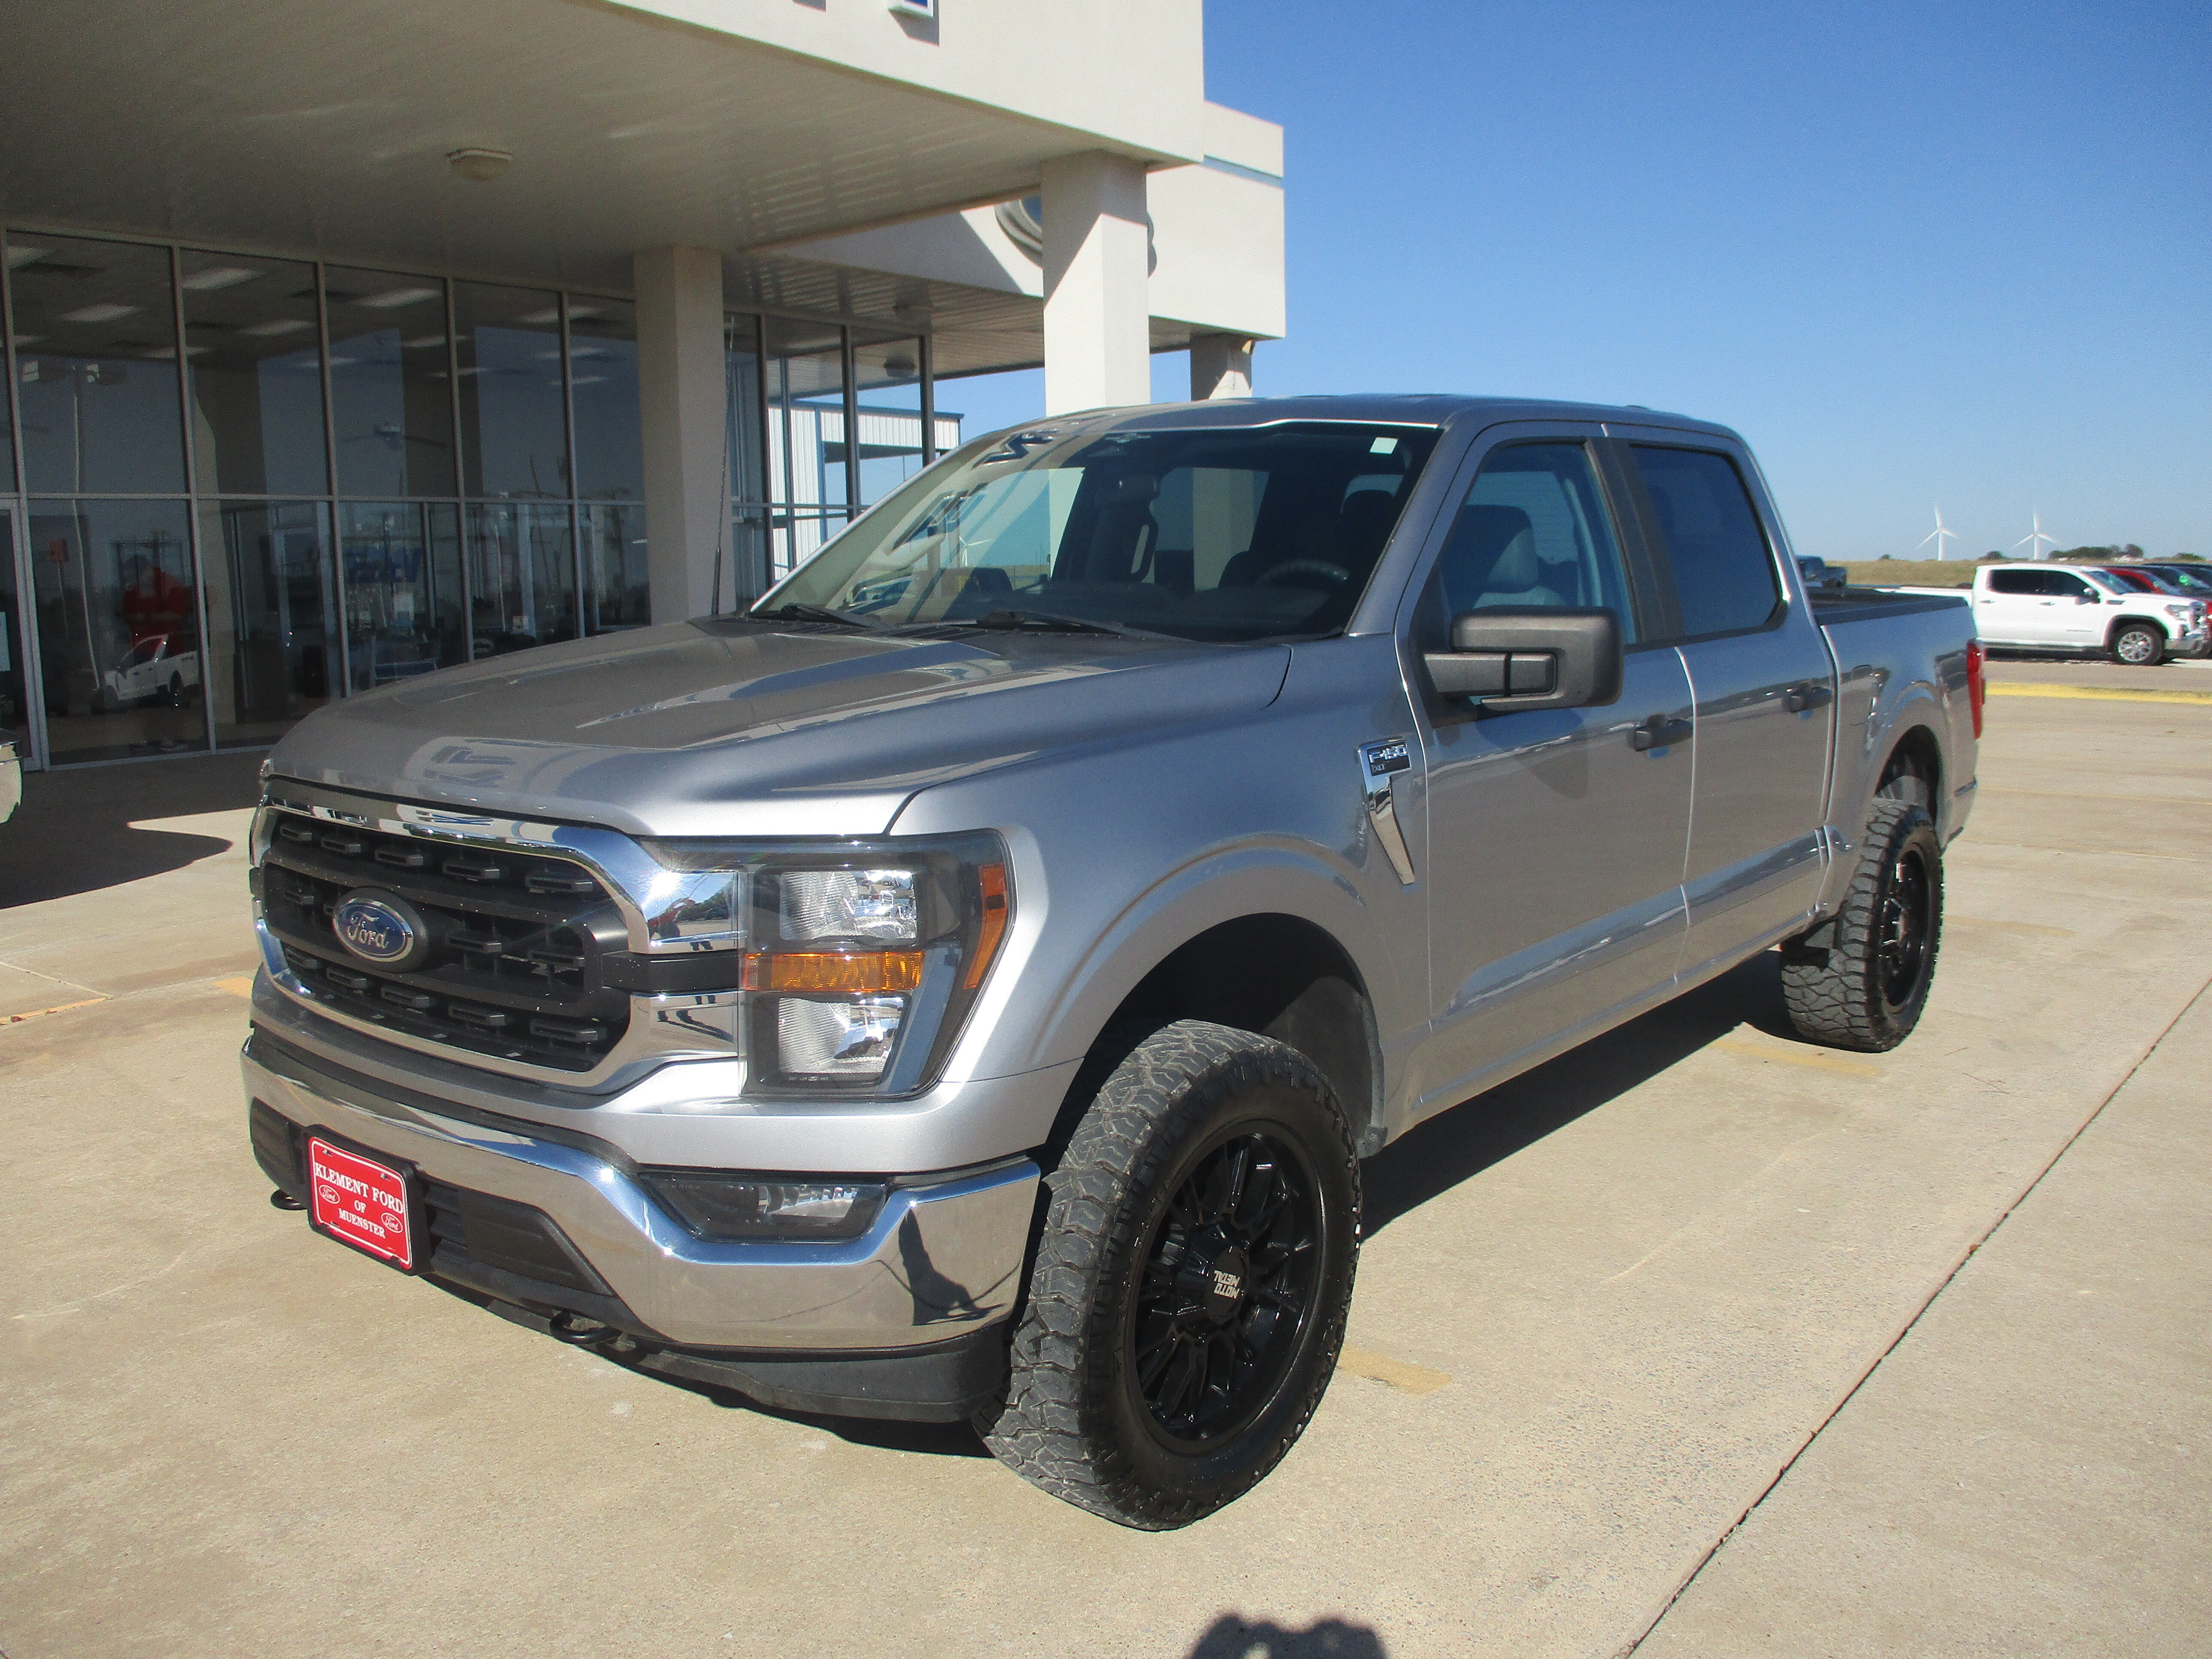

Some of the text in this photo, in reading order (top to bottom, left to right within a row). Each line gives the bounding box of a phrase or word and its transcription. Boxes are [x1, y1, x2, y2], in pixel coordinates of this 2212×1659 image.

[346, 911, 389, 949] Ford
[315, 1162, 404, 1214] KLEMENT FORD
[322, 1187, 337, 1202] Ford
[354, 1200, 367, 1213] OF
[338, 1208, 386, 1239] MUENSTER
[385, 1215, 399, 1231] Ford
[1213, 1270, 1241, 1287] METAL
[1213, 1283, 1240, 1299] MOTO
